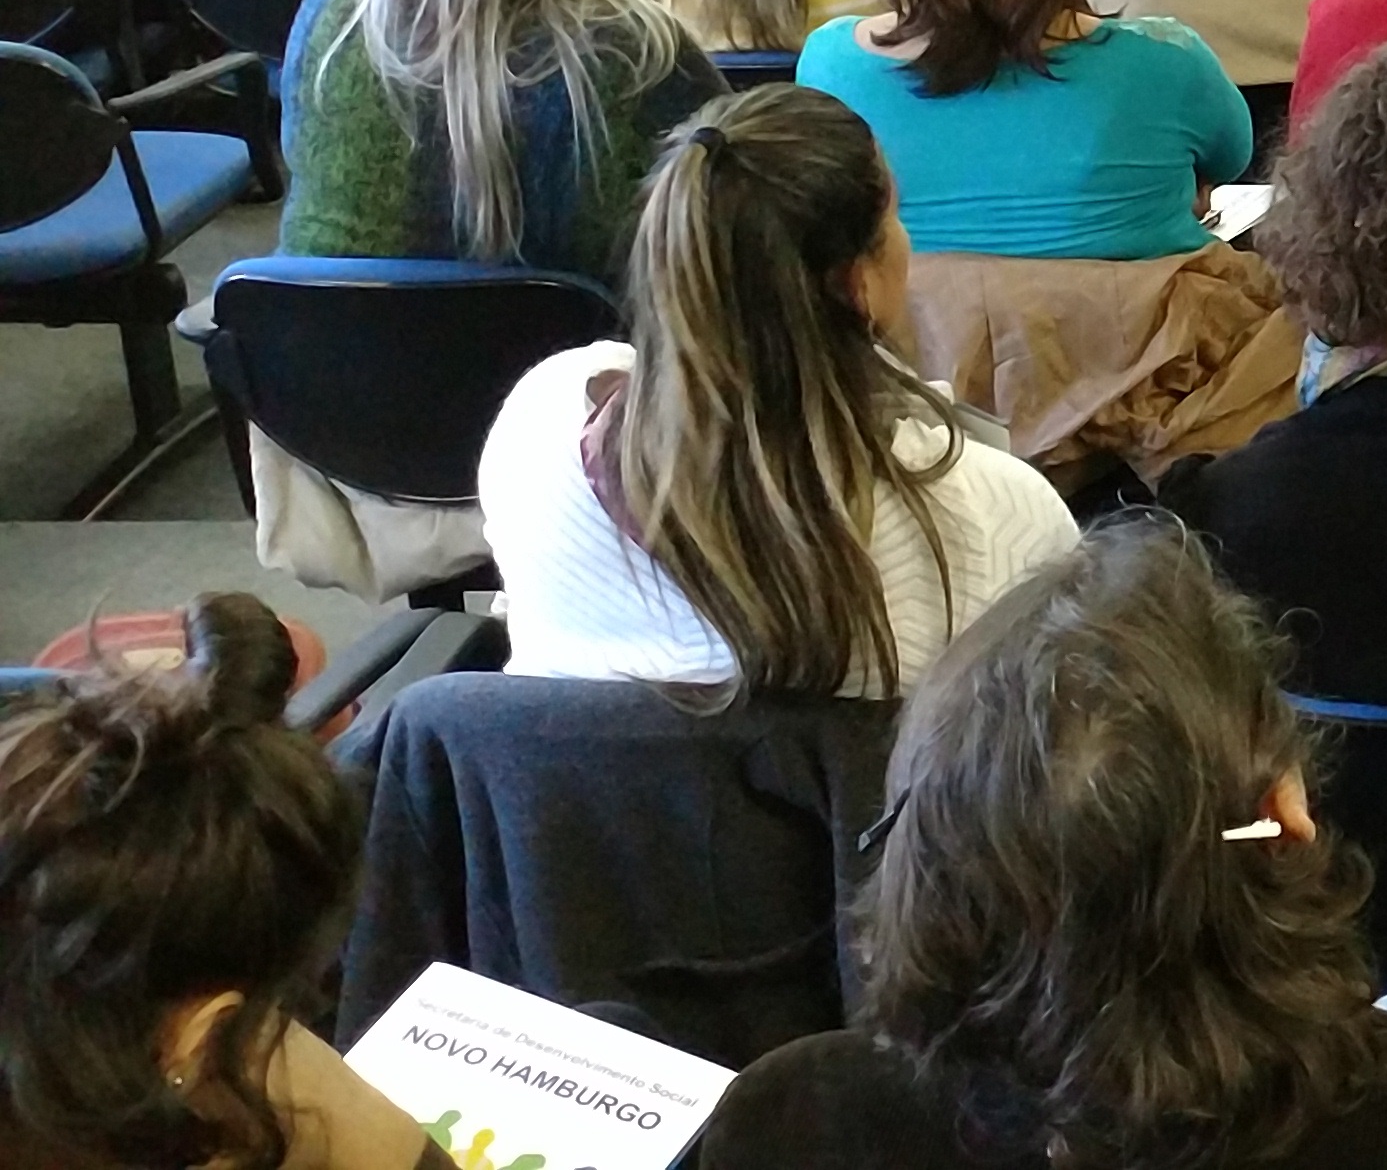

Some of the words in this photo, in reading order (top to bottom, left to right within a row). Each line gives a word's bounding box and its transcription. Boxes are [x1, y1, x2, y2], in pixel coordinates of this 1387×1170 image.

[401, 1024, 488, 1066] NOVO
[490, 1055, 662, 1130] HAMBURGO
[418, 997, 490, 1031] Secretaria
[492, 1026, 512, 1038] de
[514, 1032, 646, 1089] Desenvolvimento
[648, 1082, 700, 1108] Social
